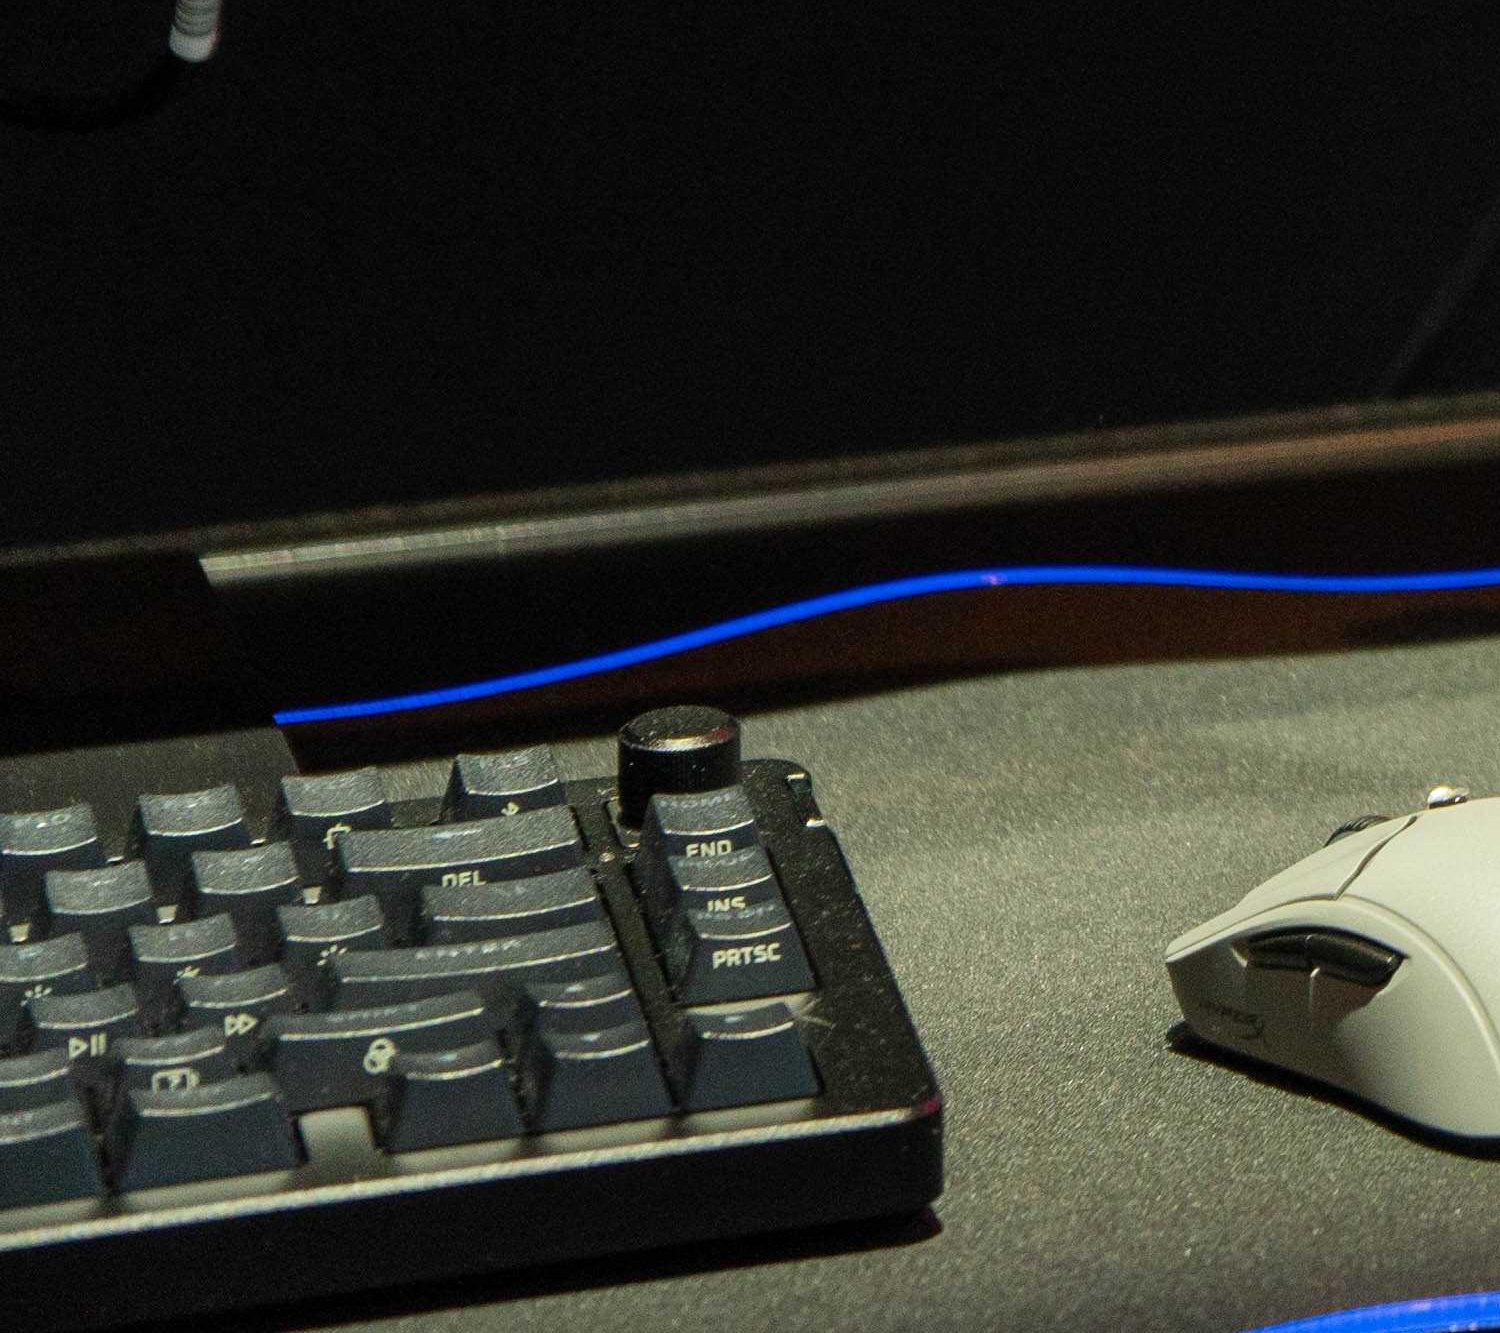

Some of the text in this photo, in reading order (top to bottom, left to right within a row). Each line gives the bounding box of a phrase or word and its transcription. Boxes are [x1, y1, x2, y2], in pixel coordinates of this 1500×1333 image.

[686, 839, 732, 857] END
[707, 896, 746, 912] INS
[712, 942, 782, 969] PRTSC
